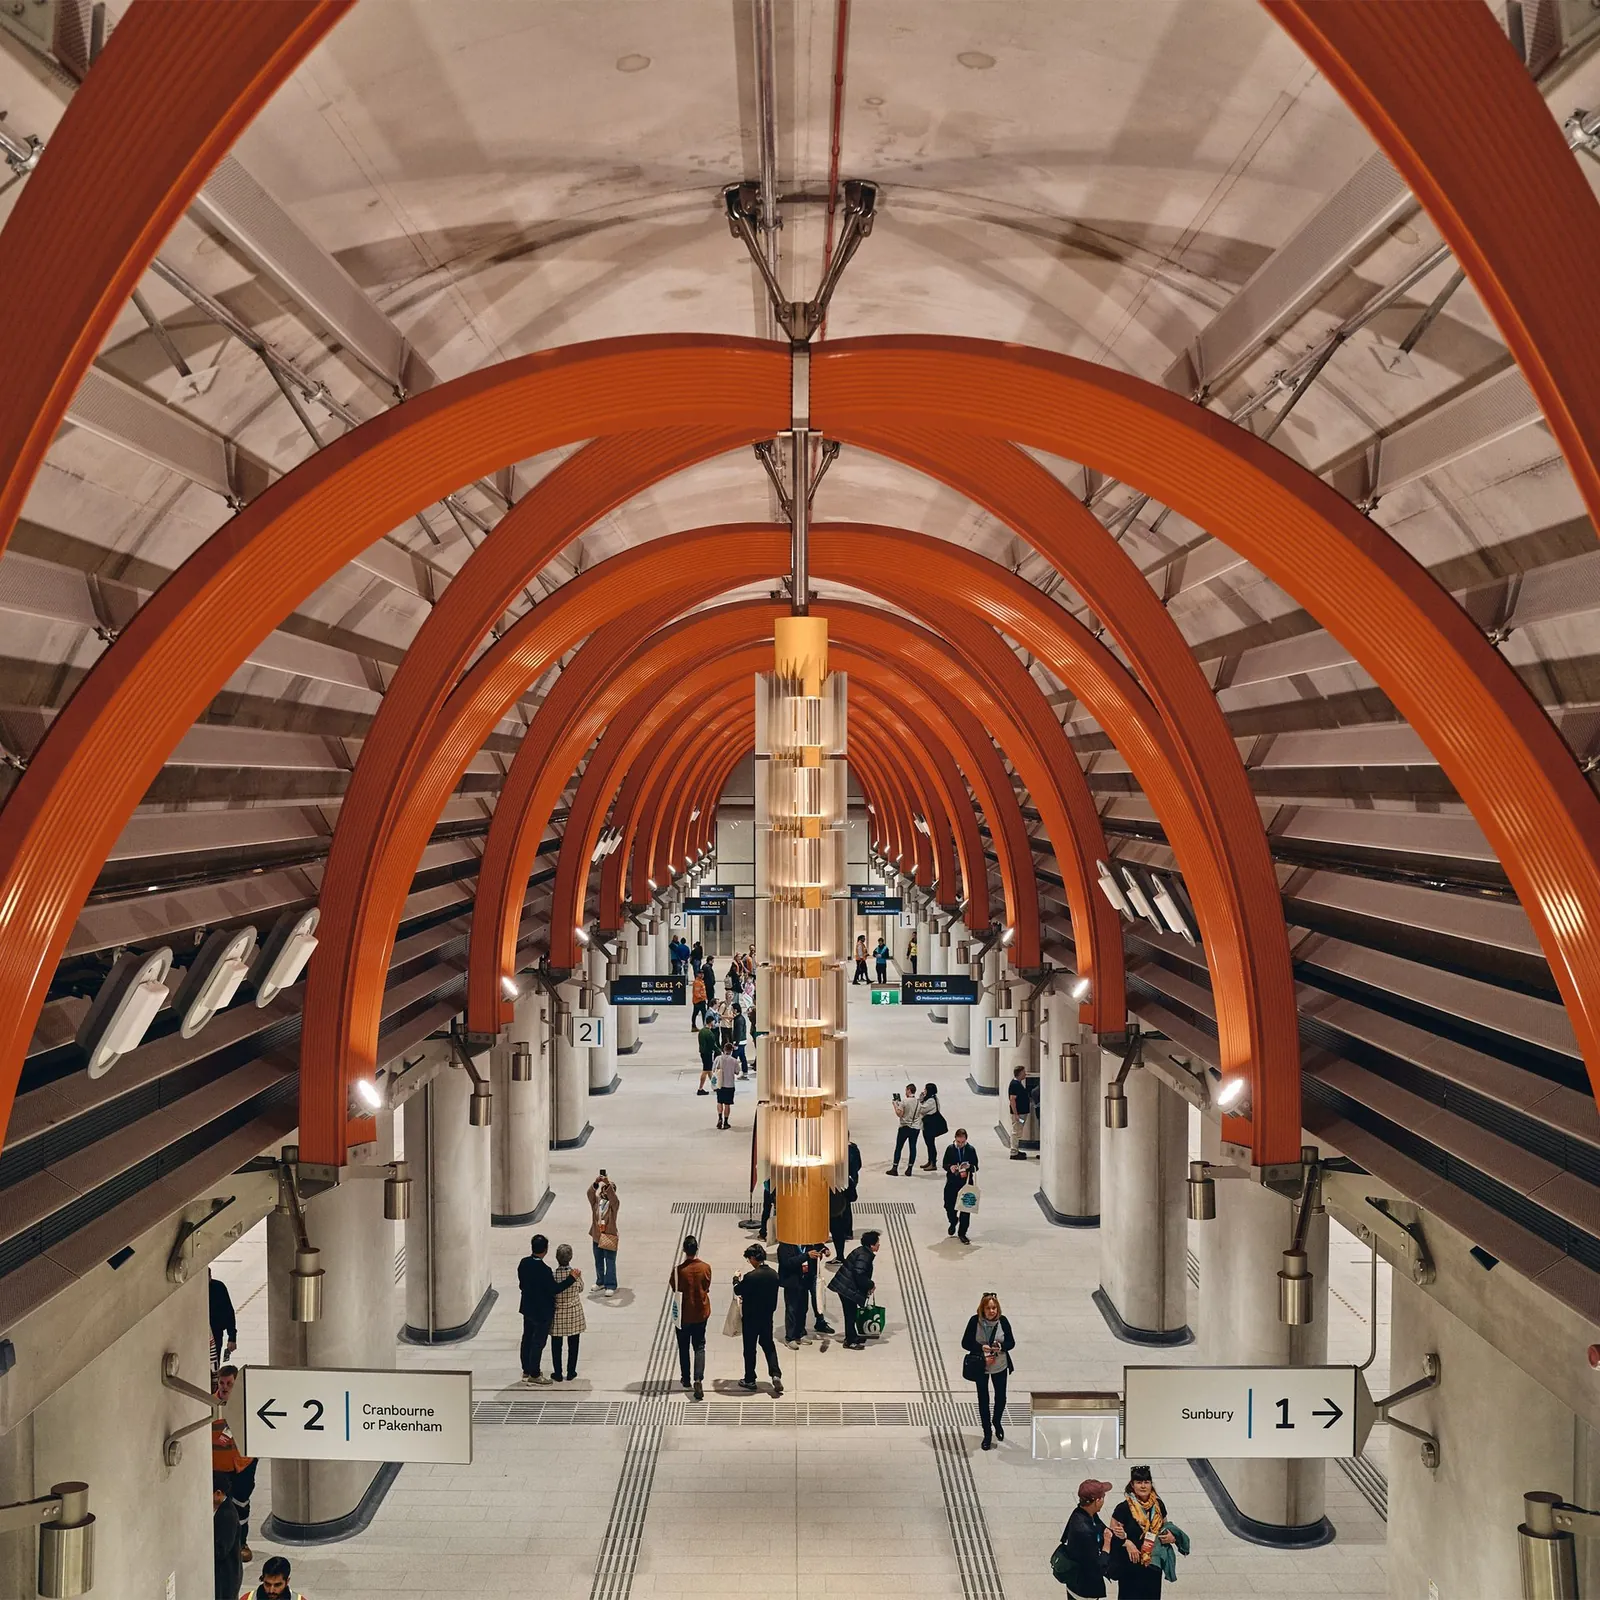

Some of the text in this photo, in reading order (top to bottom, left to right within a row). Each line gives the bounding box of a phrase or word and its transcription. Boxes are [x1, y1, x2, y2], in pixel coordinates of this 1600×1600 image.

[673, 914, 681, 926] 2
[906, 914, 912, 926] 1
[580, 1022, 592, 1042] 2
[1000, 1022, 1008, 1042] 1
[303, 1399, 324, 1431] 2
[362, 1403, 435, 1417] Cranbourne
[1181, 1408, 1234, 1422] Sunbury
[1275, 1398, 1295, 1429] 1
[362, 1419, 442, 1432] or Pakenham
